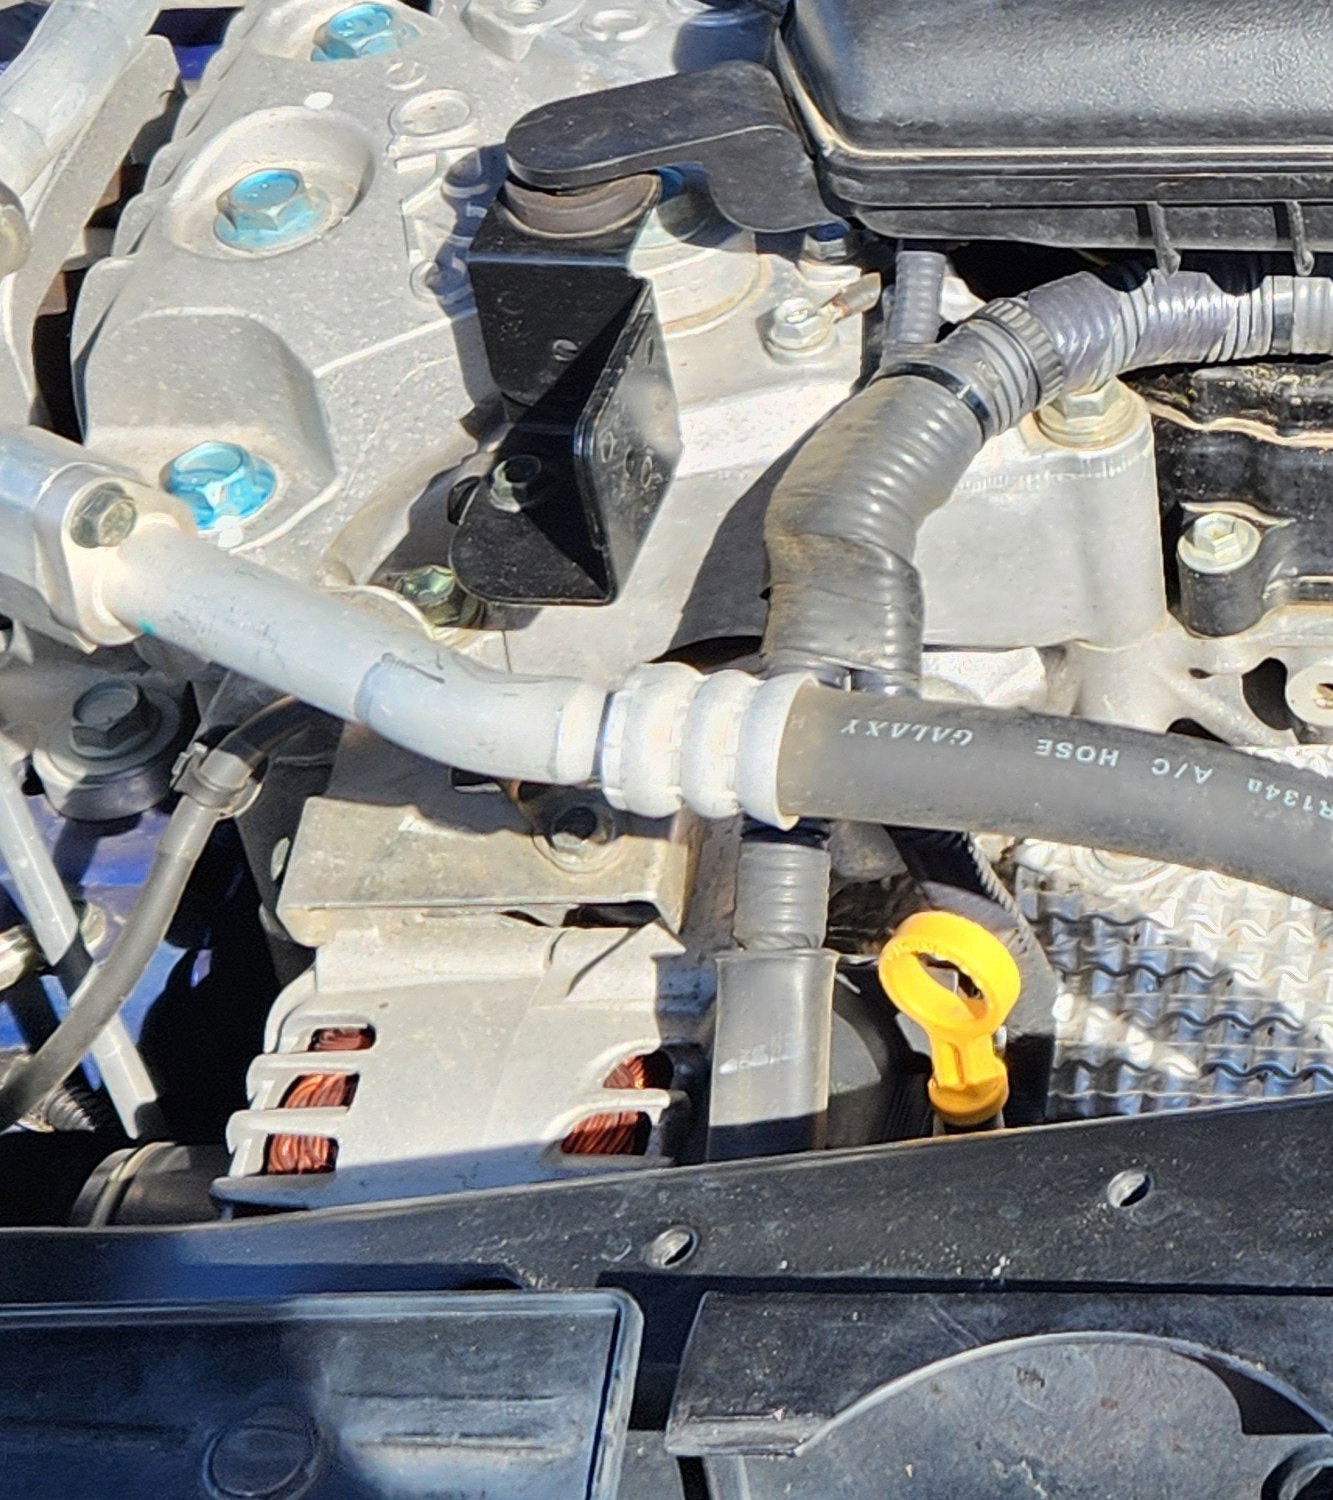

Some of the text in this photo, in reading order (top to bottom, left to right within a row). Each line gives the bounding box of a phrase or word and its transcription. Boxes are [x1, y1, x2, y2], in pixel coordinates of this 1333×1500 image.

[840, 717, 974, 748] GALAXY
[1034, 738, 1120, 768] HOSE
[1151, 756, 1213, 785] A/C
